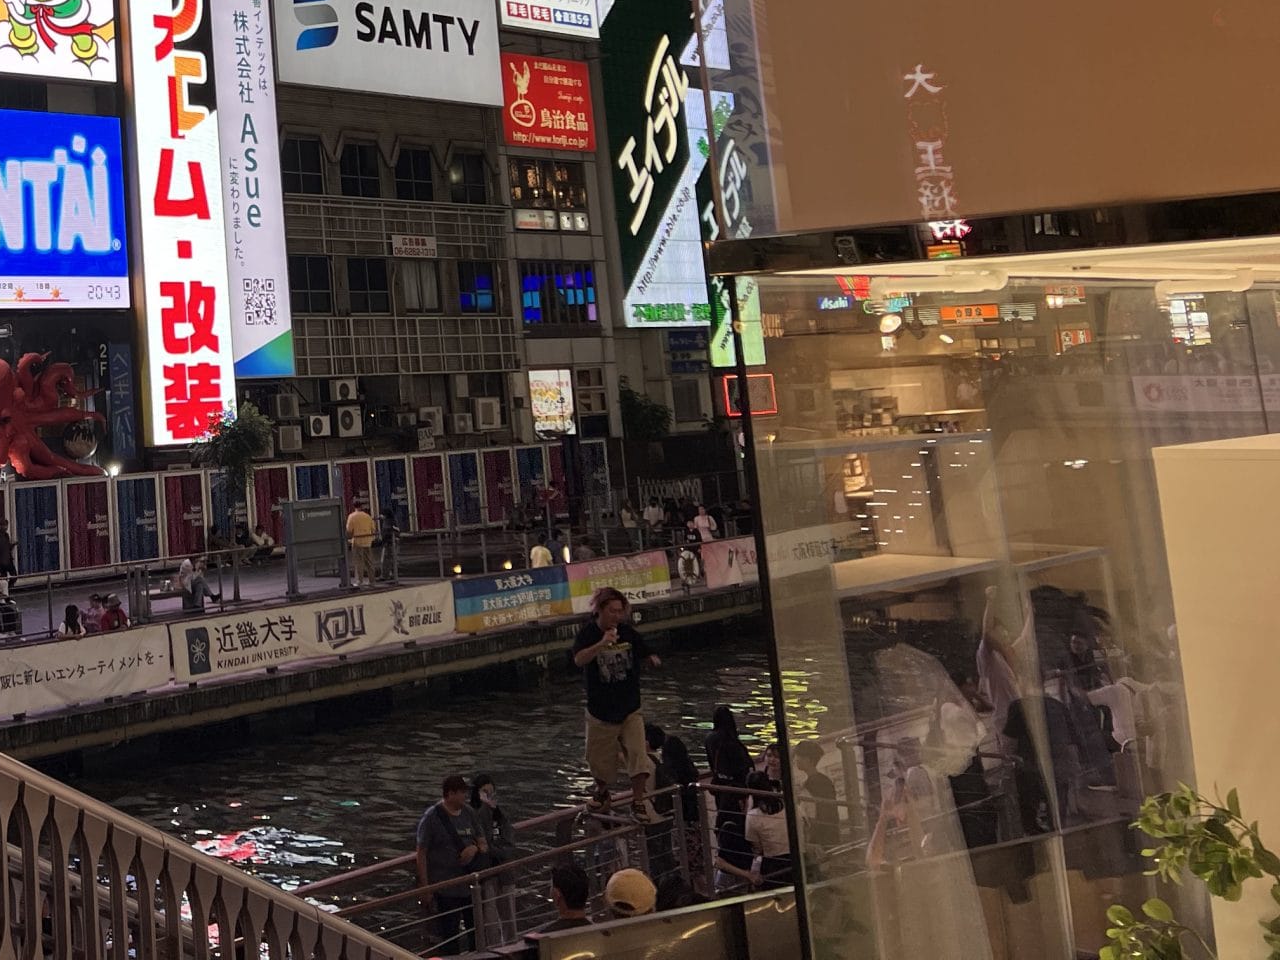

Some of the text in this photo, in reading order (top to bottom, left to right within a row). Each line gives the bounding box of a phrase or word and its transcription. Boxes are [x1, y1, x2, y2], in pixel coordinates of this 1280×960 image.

[355, 1, 480, 56] SAMTY
[233, 10, 262, 228] 株式会社 Asue
[229, 157, 245, 267] に変わりました。
[819, 296, 849, 310] Asahi
[214, 615, 297, 654] 近畿大学
[409, 611, 442, 628] BIG BLUE
[217, 645, 299, 669] KINDAI UNIVERSITY
